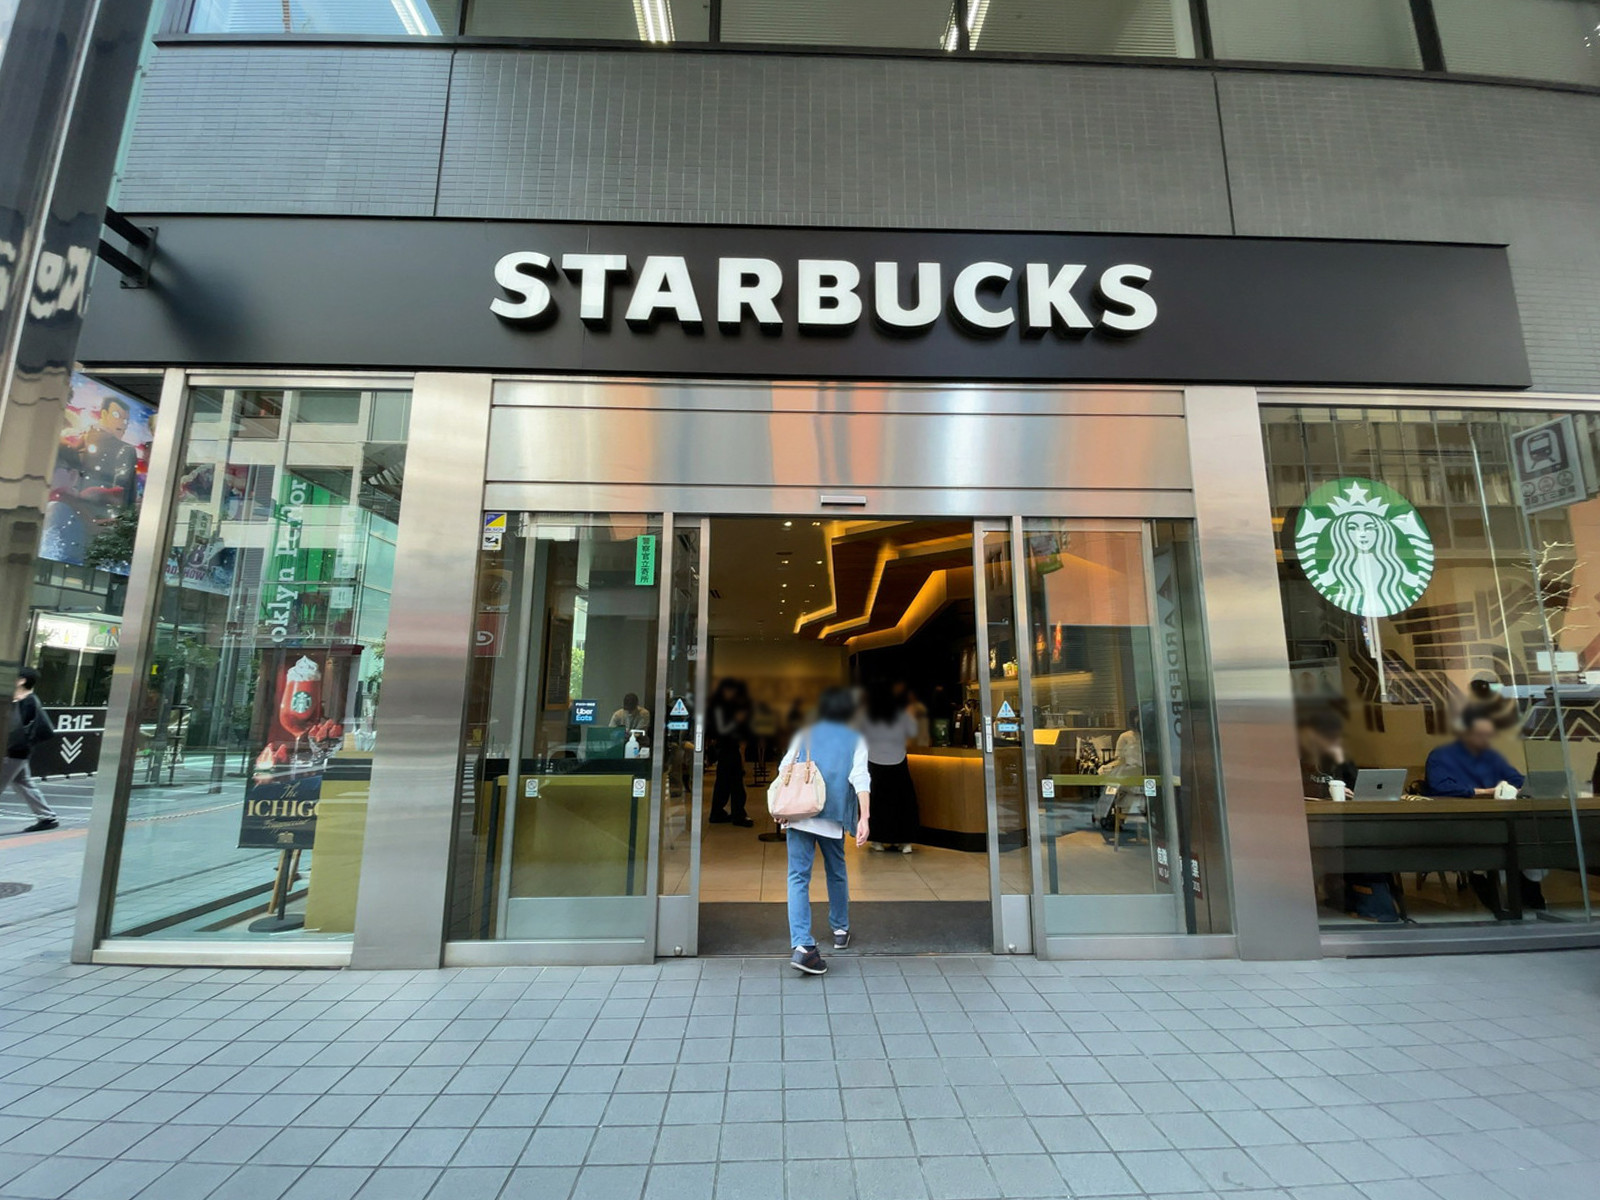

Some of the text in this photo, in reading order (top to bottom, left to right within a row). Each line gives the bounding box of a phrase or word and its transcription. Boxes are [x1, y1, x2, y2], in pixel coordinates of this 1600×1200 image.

[489, 250, 1158, 332] STARBUCKS
[640, 537, 651, 583] 警察官立寄所
[57, 714, 94, 730] B1F
